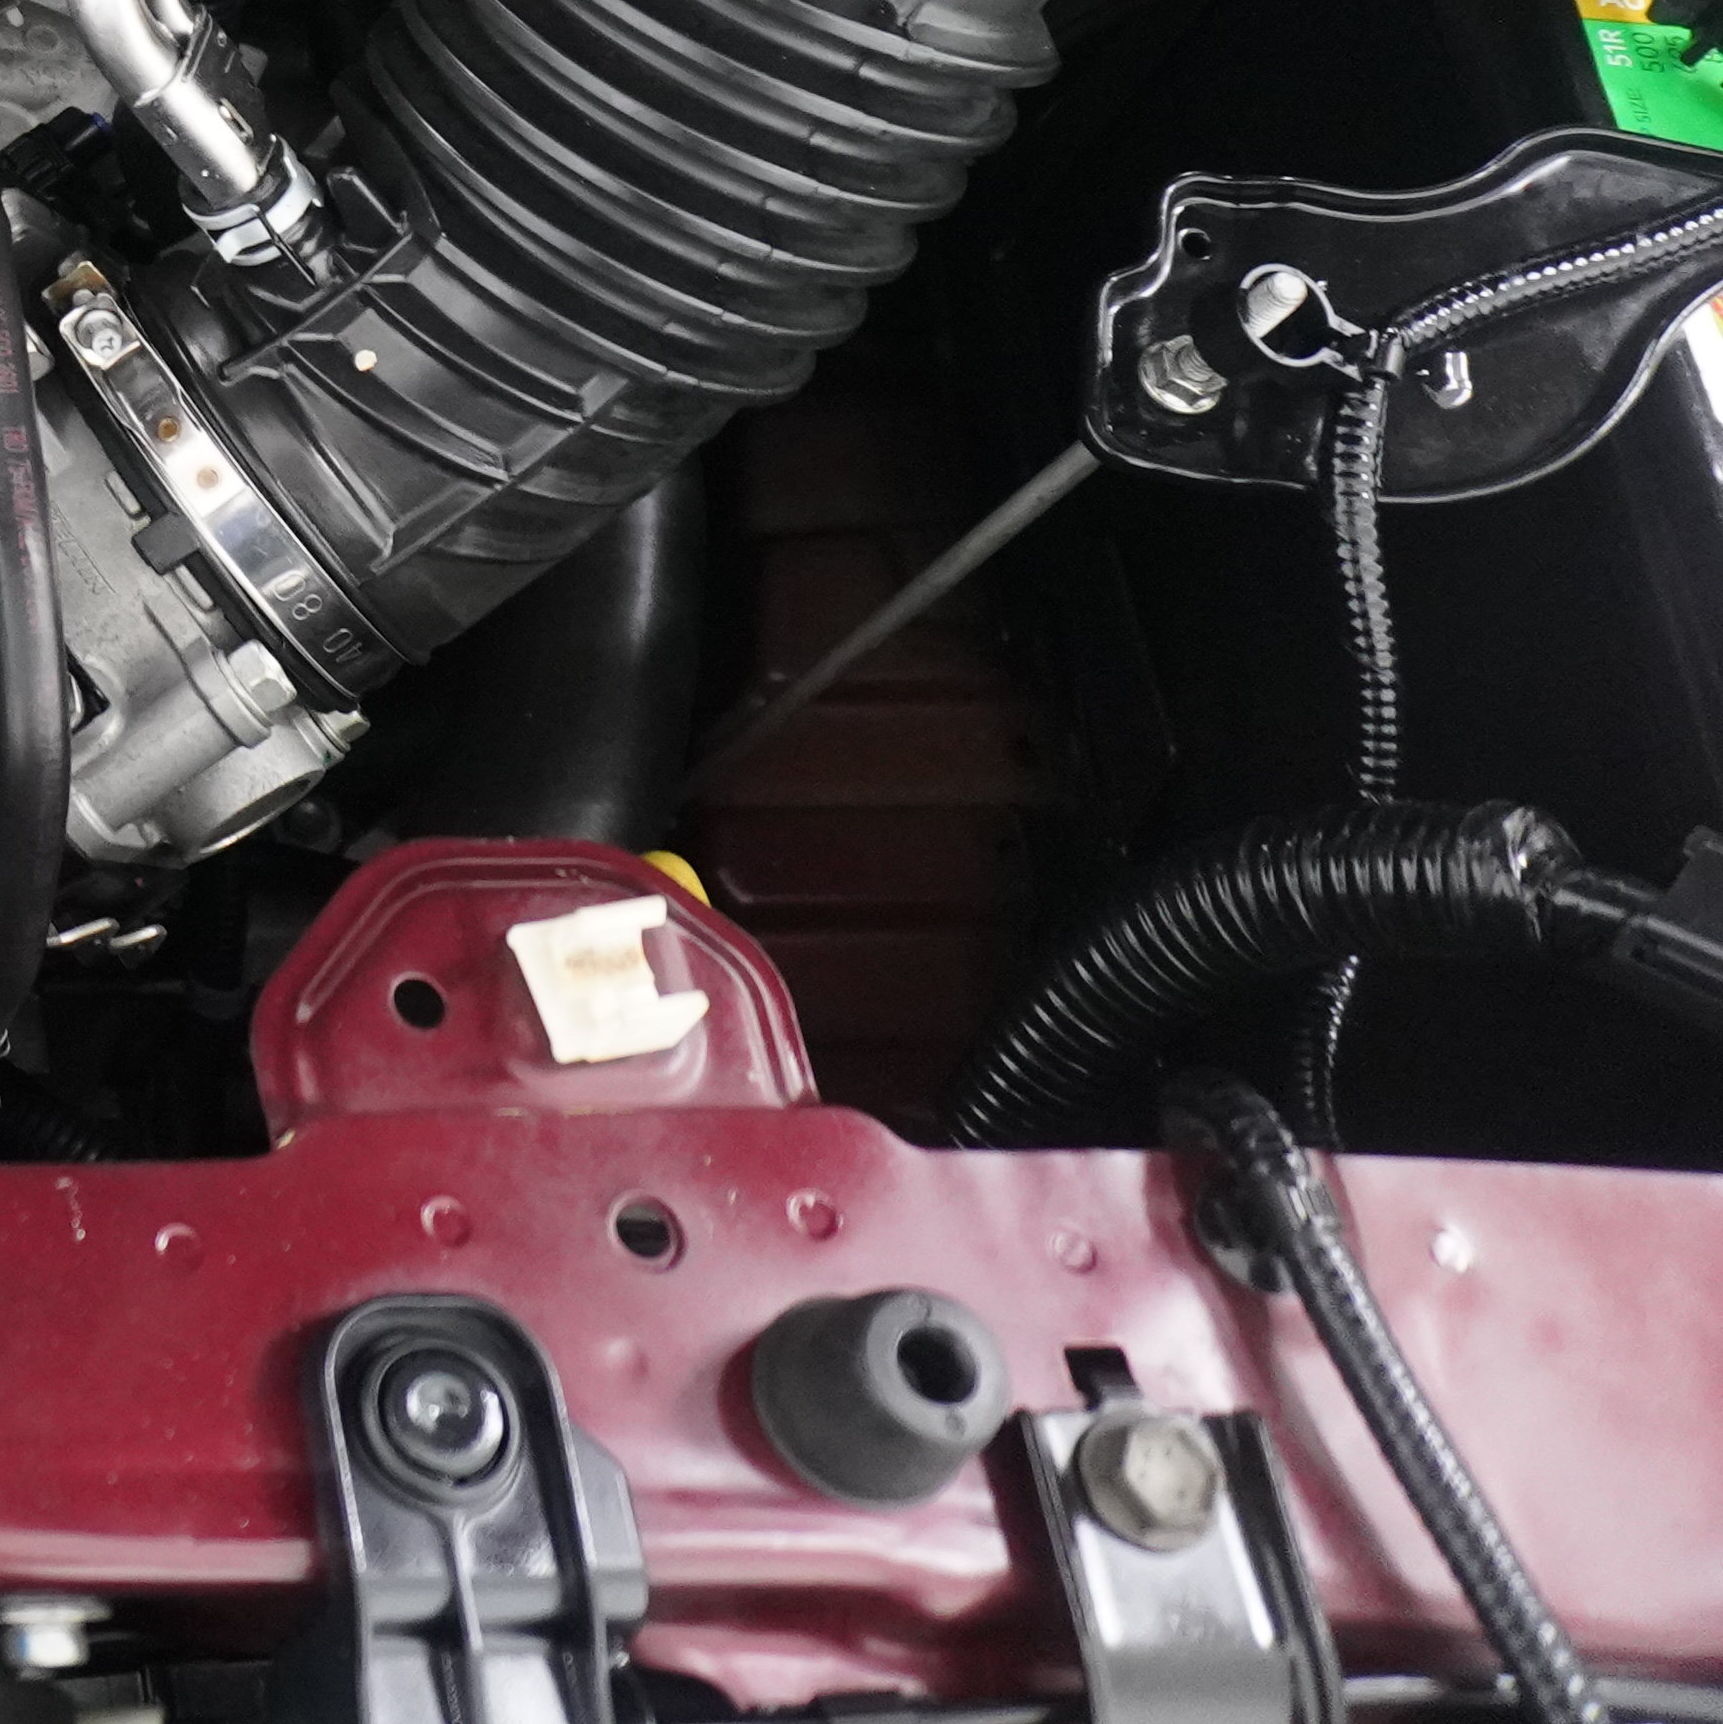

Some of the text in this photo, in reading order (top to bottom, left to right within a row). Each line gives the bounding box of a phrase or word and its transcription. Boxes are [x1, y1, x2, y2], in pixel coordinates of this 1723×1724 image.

[1598, 28, 1632, 68] 51R
[1632, 32, 1664, 73] 500
[274, 572, 323, 621] 80
